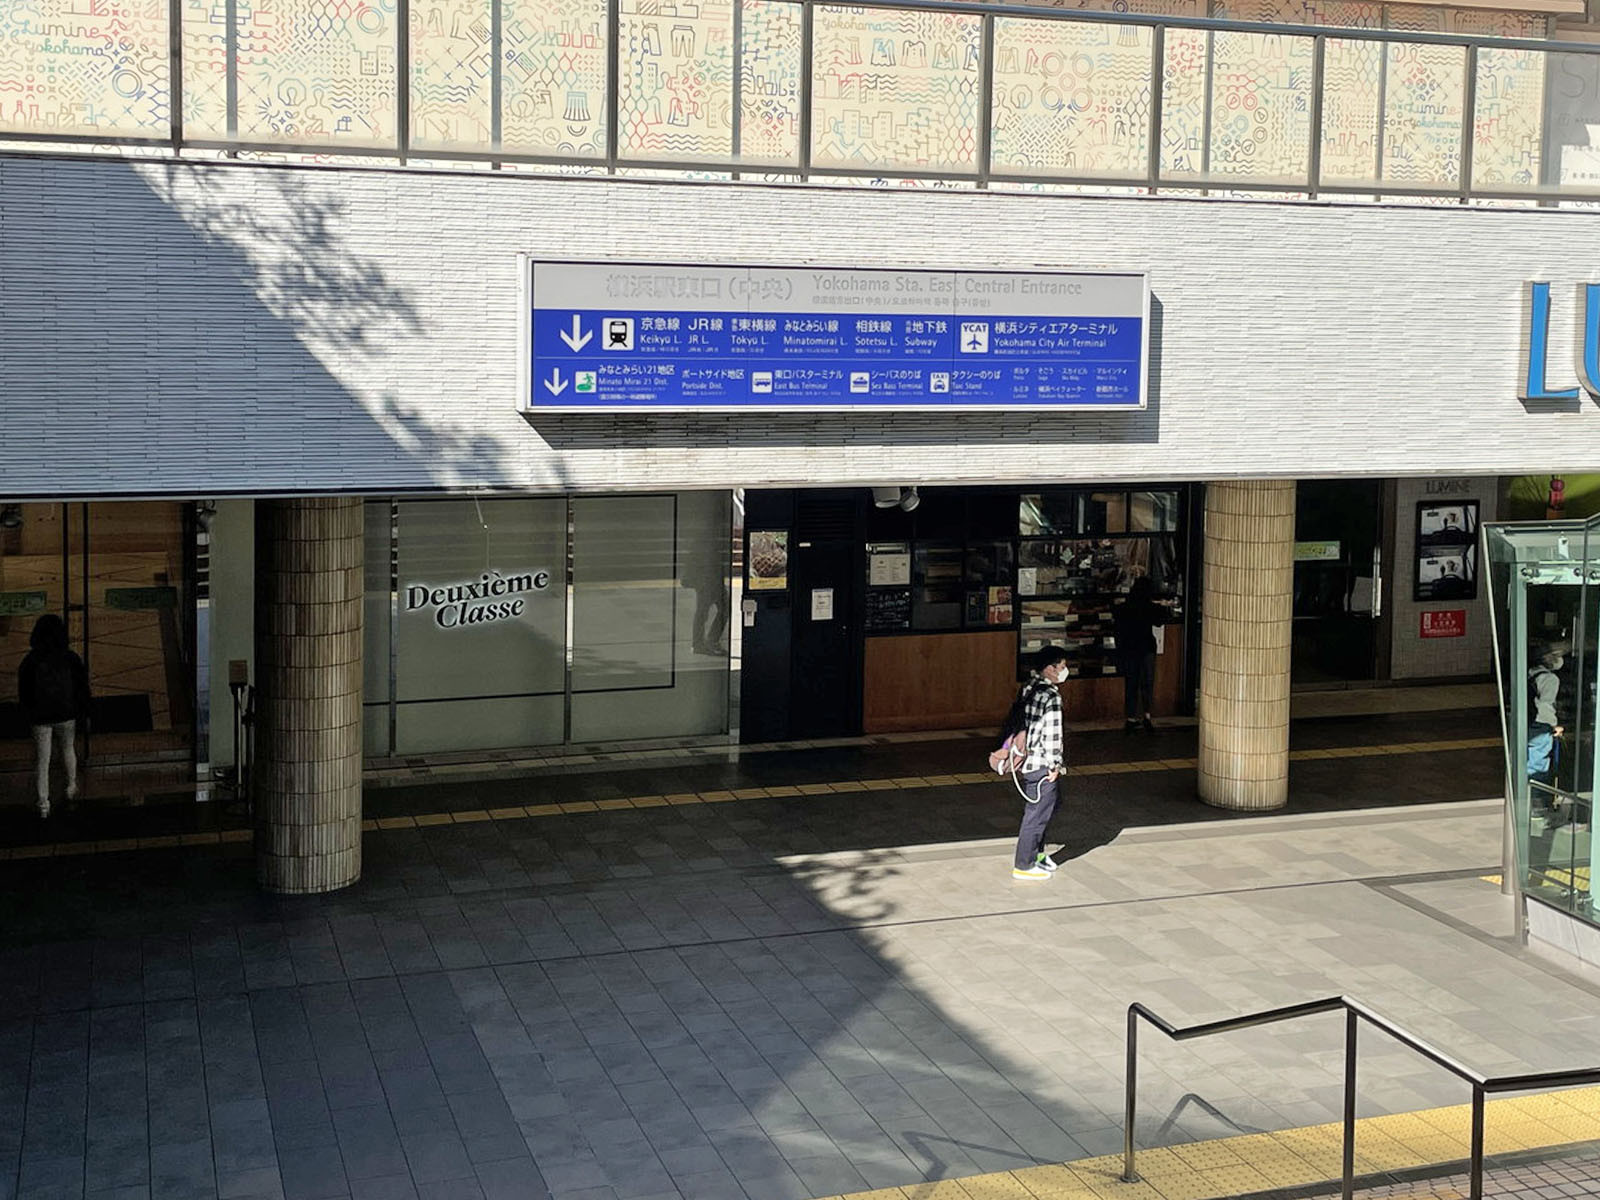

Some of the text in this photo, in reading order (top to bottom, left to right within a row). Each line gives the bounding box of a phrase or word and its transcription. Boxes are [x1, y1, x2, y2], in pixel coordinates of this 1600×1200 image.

[812, 275, 890, 291] Yokohama
[895, 276, 923, 292] Sta.
[965, 278, 1015, 293] Central
[1021, 279, 1082, 295] Entrance
[641, 317, 680, 331] 京急線
[688, 318, 723, 331] JR線
[784, 319, 839, 333] みなとみらい線
[856, 320, 892, 333] 相鉄線
[963, 324, 987, 333] YCAT
[994, 322, 1118, 336] 横浜シティエアターミナル
[674, 334, 683, 344] L.
[688, 335, 710, 345] JR L.
[783, 336, 848, 346] Minatomirai L.
[890, 336, 898, 346] L.
[904, 336, 938, 348] Subway
[994, 338, 1106, 349] Yokohama City Air Terminal
[598, 364, 675, 375] みなとみらい21地区
[682, 368, 745, 380] ポートサイド地区
[774, 369, 844, 380] 東口バスターミナル
[871, 370, 922, 380] シーバスのりば
[952, 370, 1002, 380] タクシーのりば
[598, 377, 623, 386] Minato
[624, 377, 642, 386] Mirai
[774, 381, 828, 390] East Bus Terminal
[871, 382, 882, 390] Sea
[1426, 479, 1470, 494] LUMINE
[406, 571, 549, 611] Deuxième
[436, 599, 524, 628] Classe
